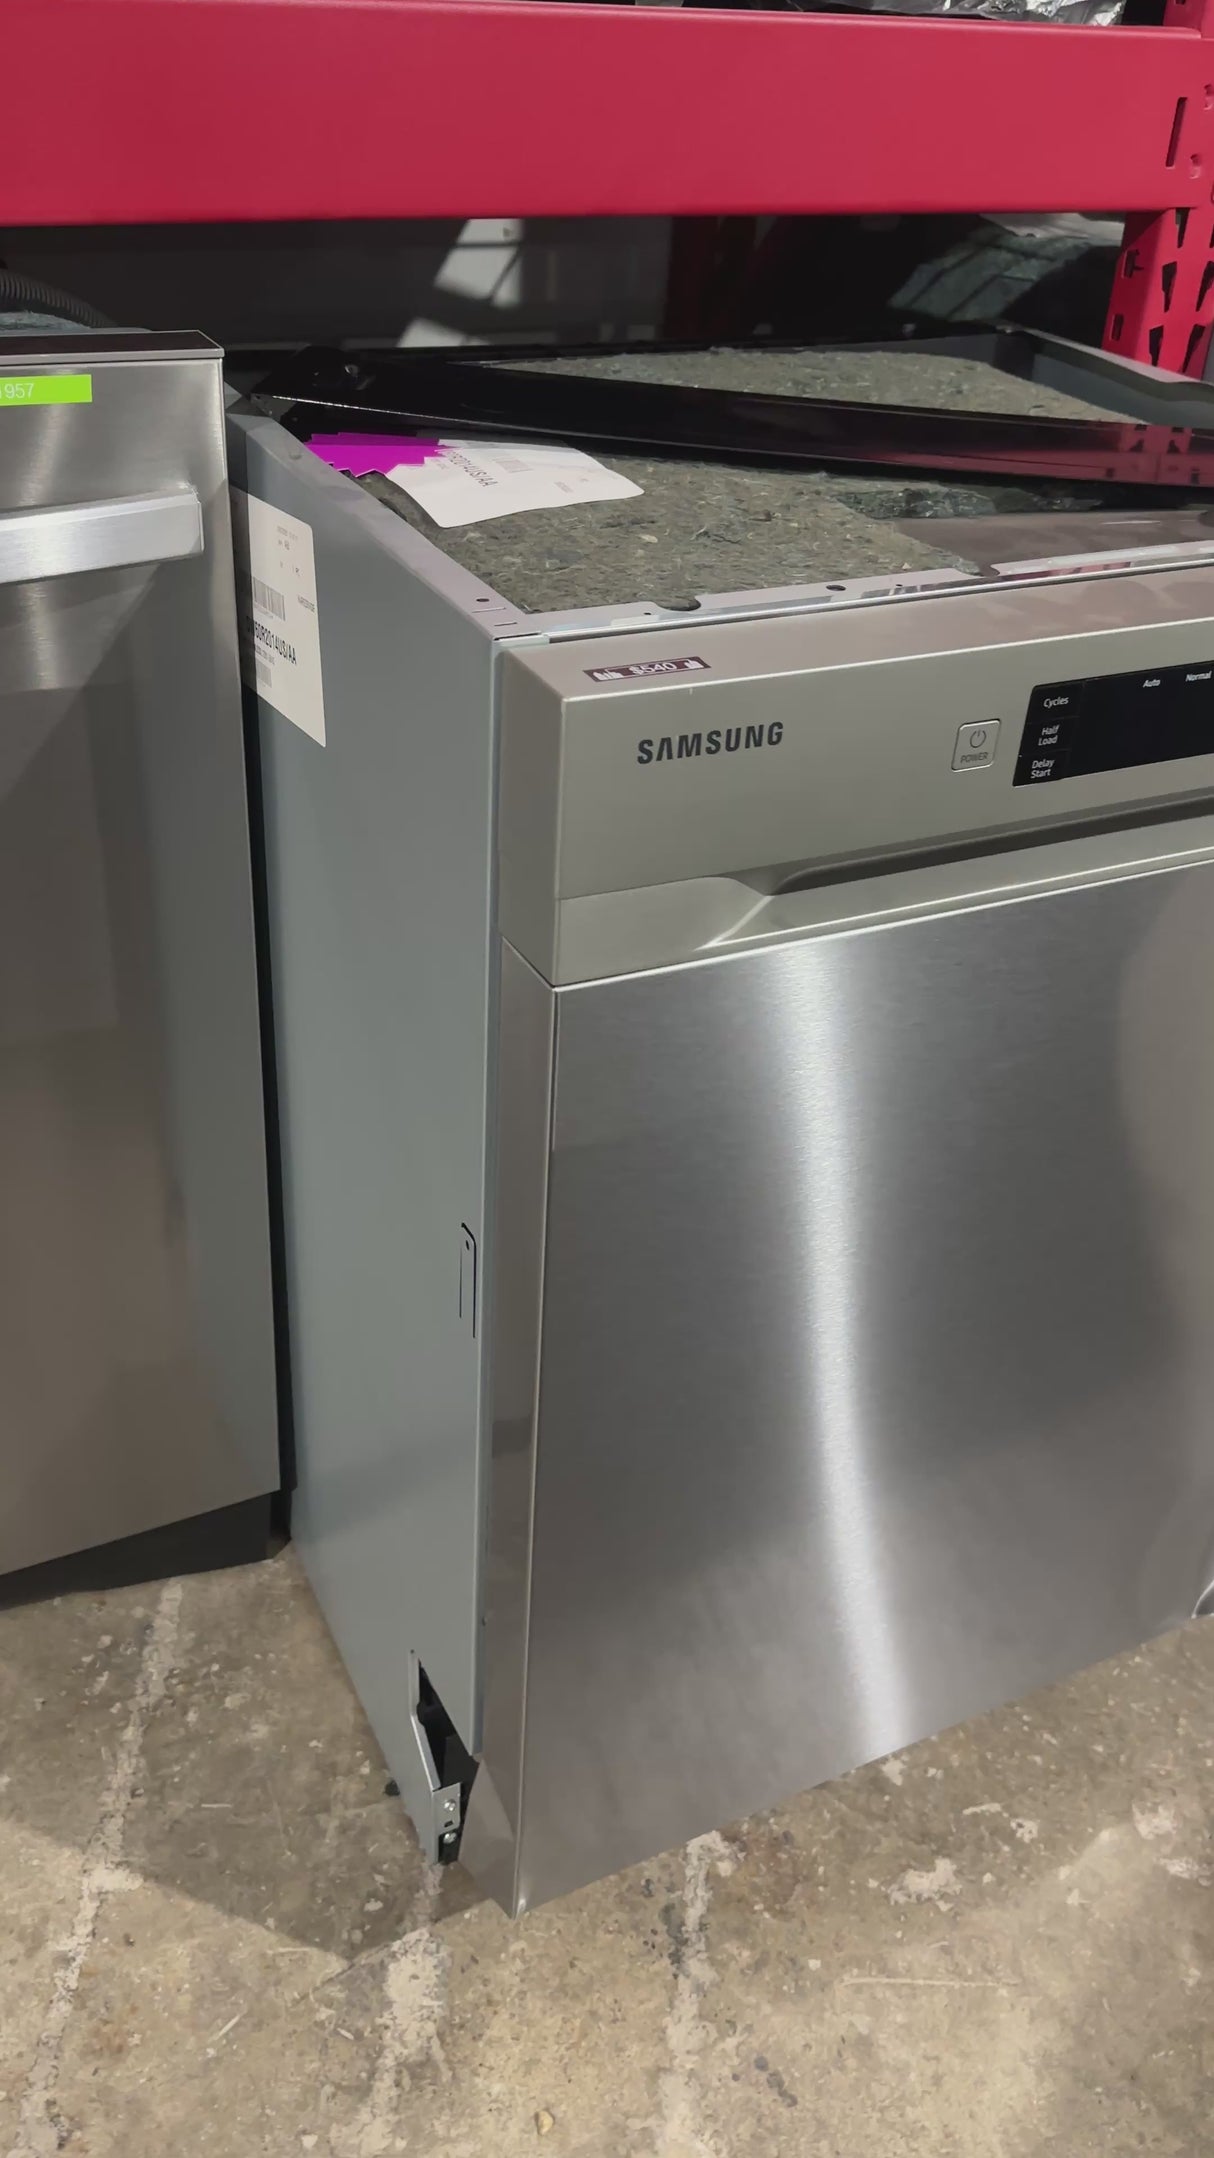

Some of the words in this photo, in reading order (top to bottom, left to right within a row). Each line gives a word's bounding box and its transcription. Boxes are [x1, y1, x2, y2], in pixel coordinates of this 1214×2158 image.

[0, 382, 34, 399] 957
[629, 662, 678, 675] $540
[1142, 679, 1161, 689] Auto
[1185, 671, 1212, 683] Normal
[1043, 697, 1070, 709] Cycles
[1041, 725, 1060, 736] Half
[637, 721, 784, 765] SAMSUNG
[1038, 735, 1059, 746] Load
[960, 752, 989, 763] POWER
[1031, 758, 1055, 769] Delay
[1030, 768, 1052, 779] Start
